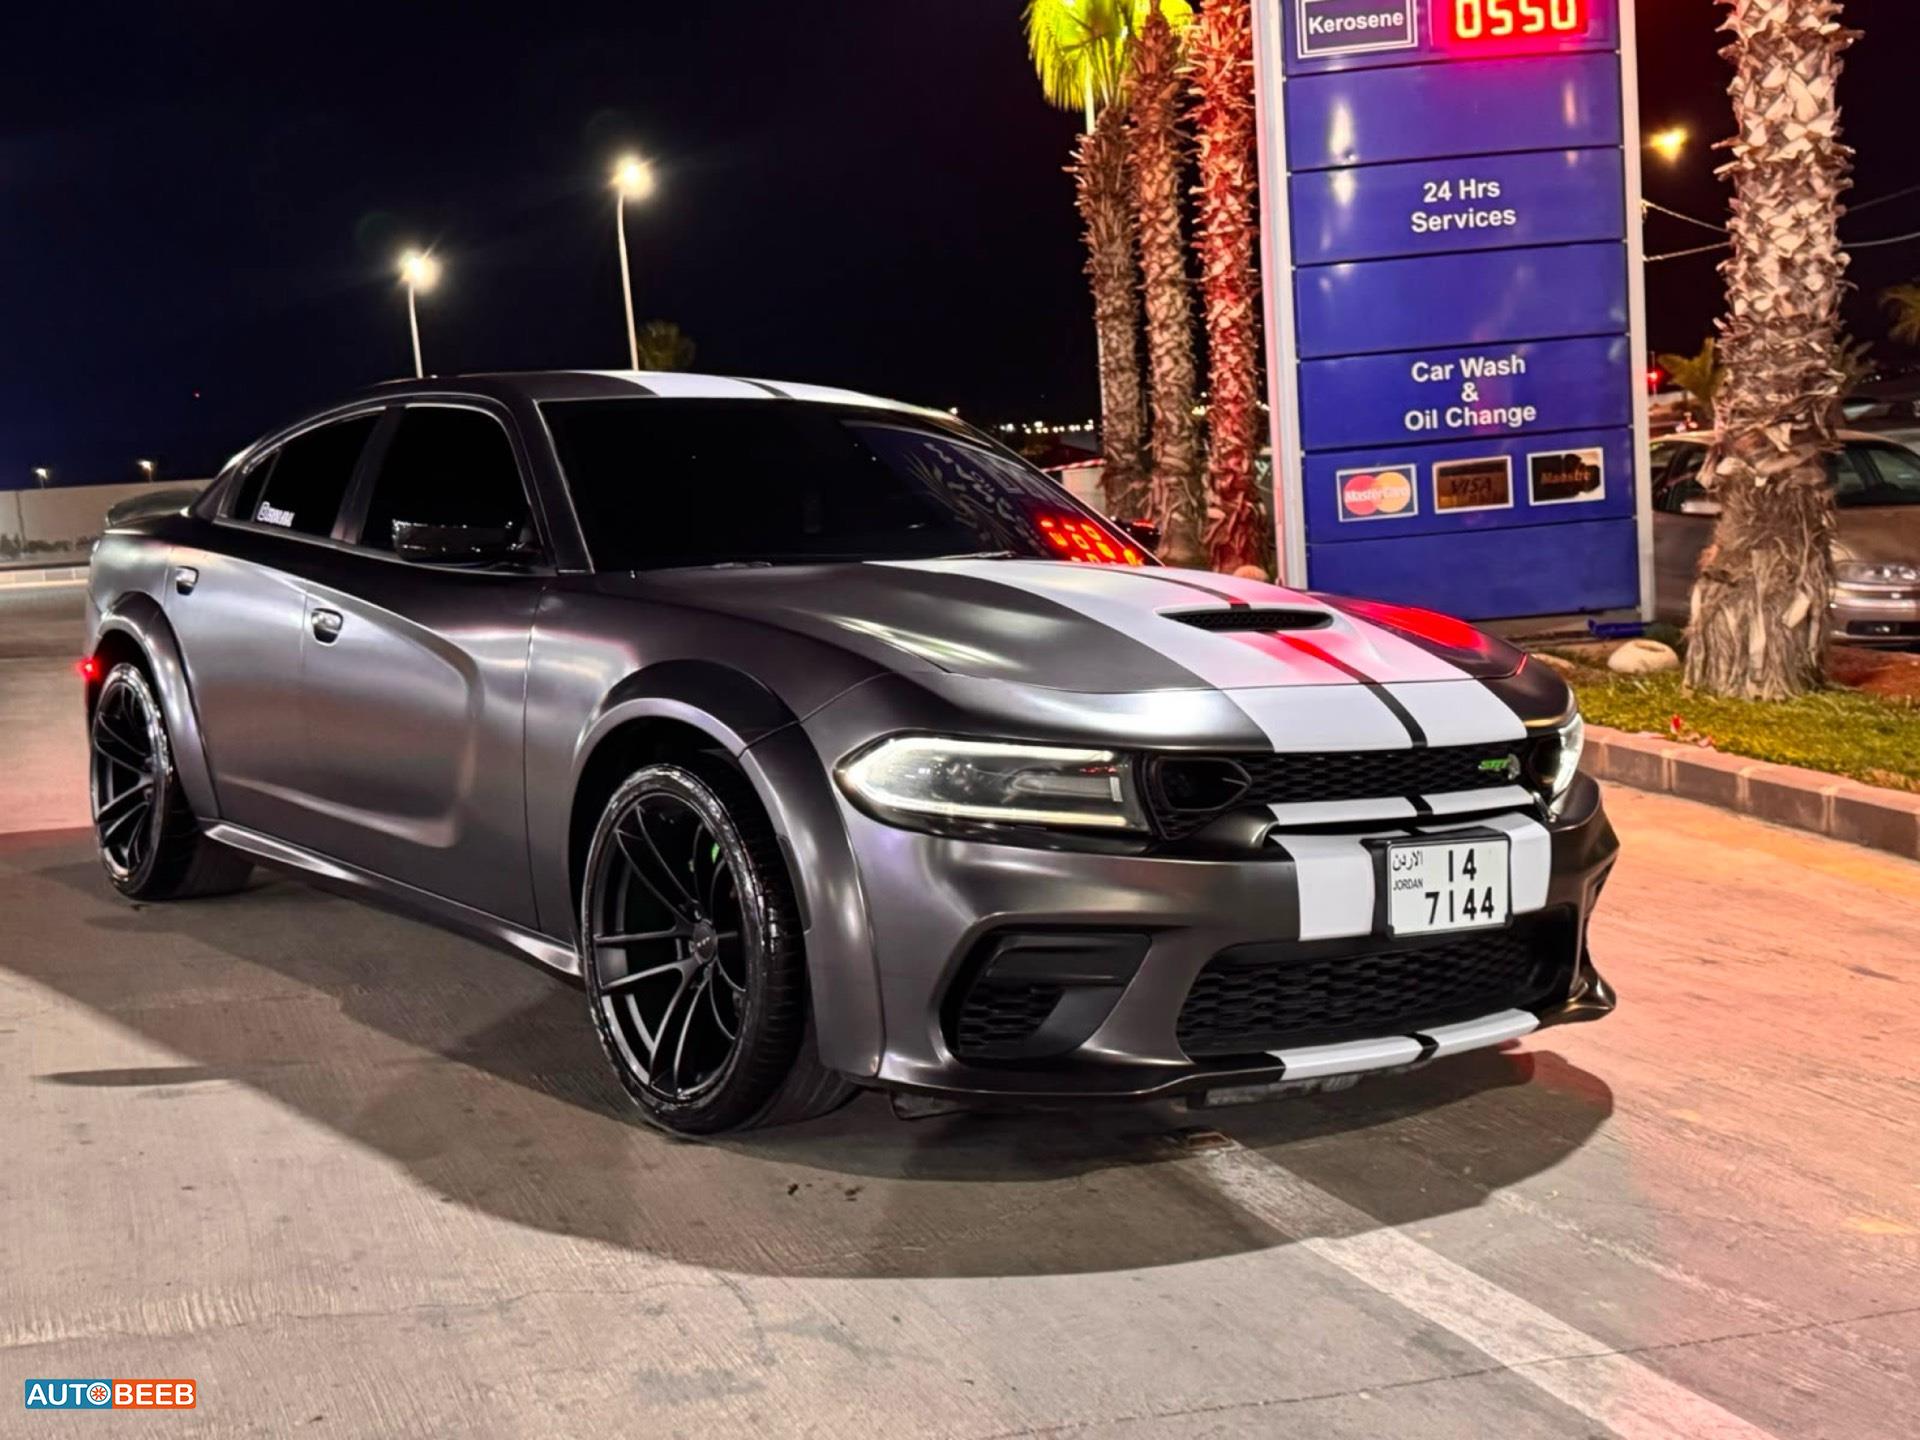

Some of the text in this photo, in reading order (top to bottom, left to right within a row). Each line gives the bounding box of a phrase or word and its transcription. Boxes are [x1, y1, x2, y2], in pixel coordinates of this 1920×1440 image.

[1308, 11, 1404, 35] Kerosene
[1456, 0, 1577, 38] 0550
[1423, 179, 1501, 203] 24 Hrs
[1410, 206, 1517, 233] Services
[1411, 355, 1526, 382] Car Wash
[1461, 382, 1479, 402] &
[1404, 405, 1537, 431] Oil Change
[1450, 477, 1493, 494] VISA
[1448, 848, 1477, 882] 14
[1392, 878, 1424, 890] JORDAN
[1425, 886, 1494, 925] 7144
